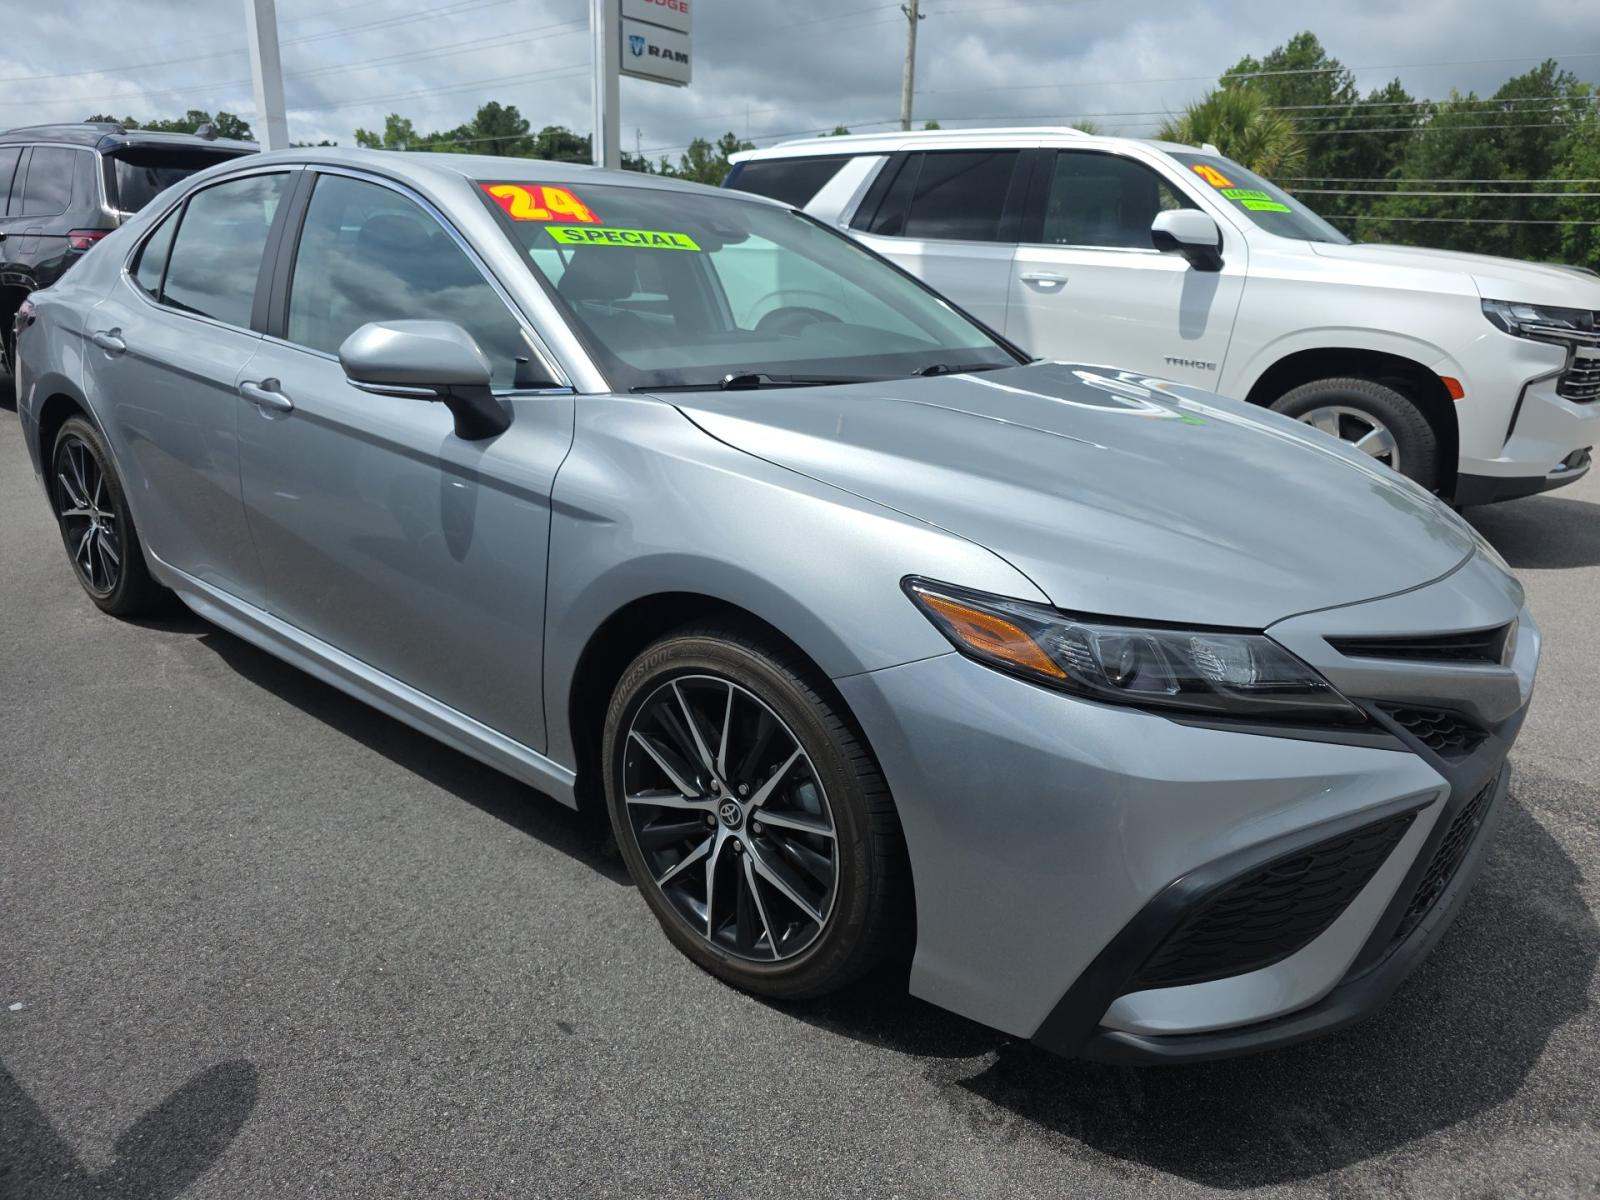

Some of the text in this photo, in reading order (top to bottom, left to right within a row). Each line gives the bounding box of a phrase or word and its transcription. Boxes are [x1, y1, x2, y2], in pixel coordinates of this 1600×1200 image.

[648, 45, 688, 64] RAM
[489, 185, 593, 223] 24
[563, 229, 687, 247] SPECIAL
[1164, 357, 1217, 371] TAHOE
